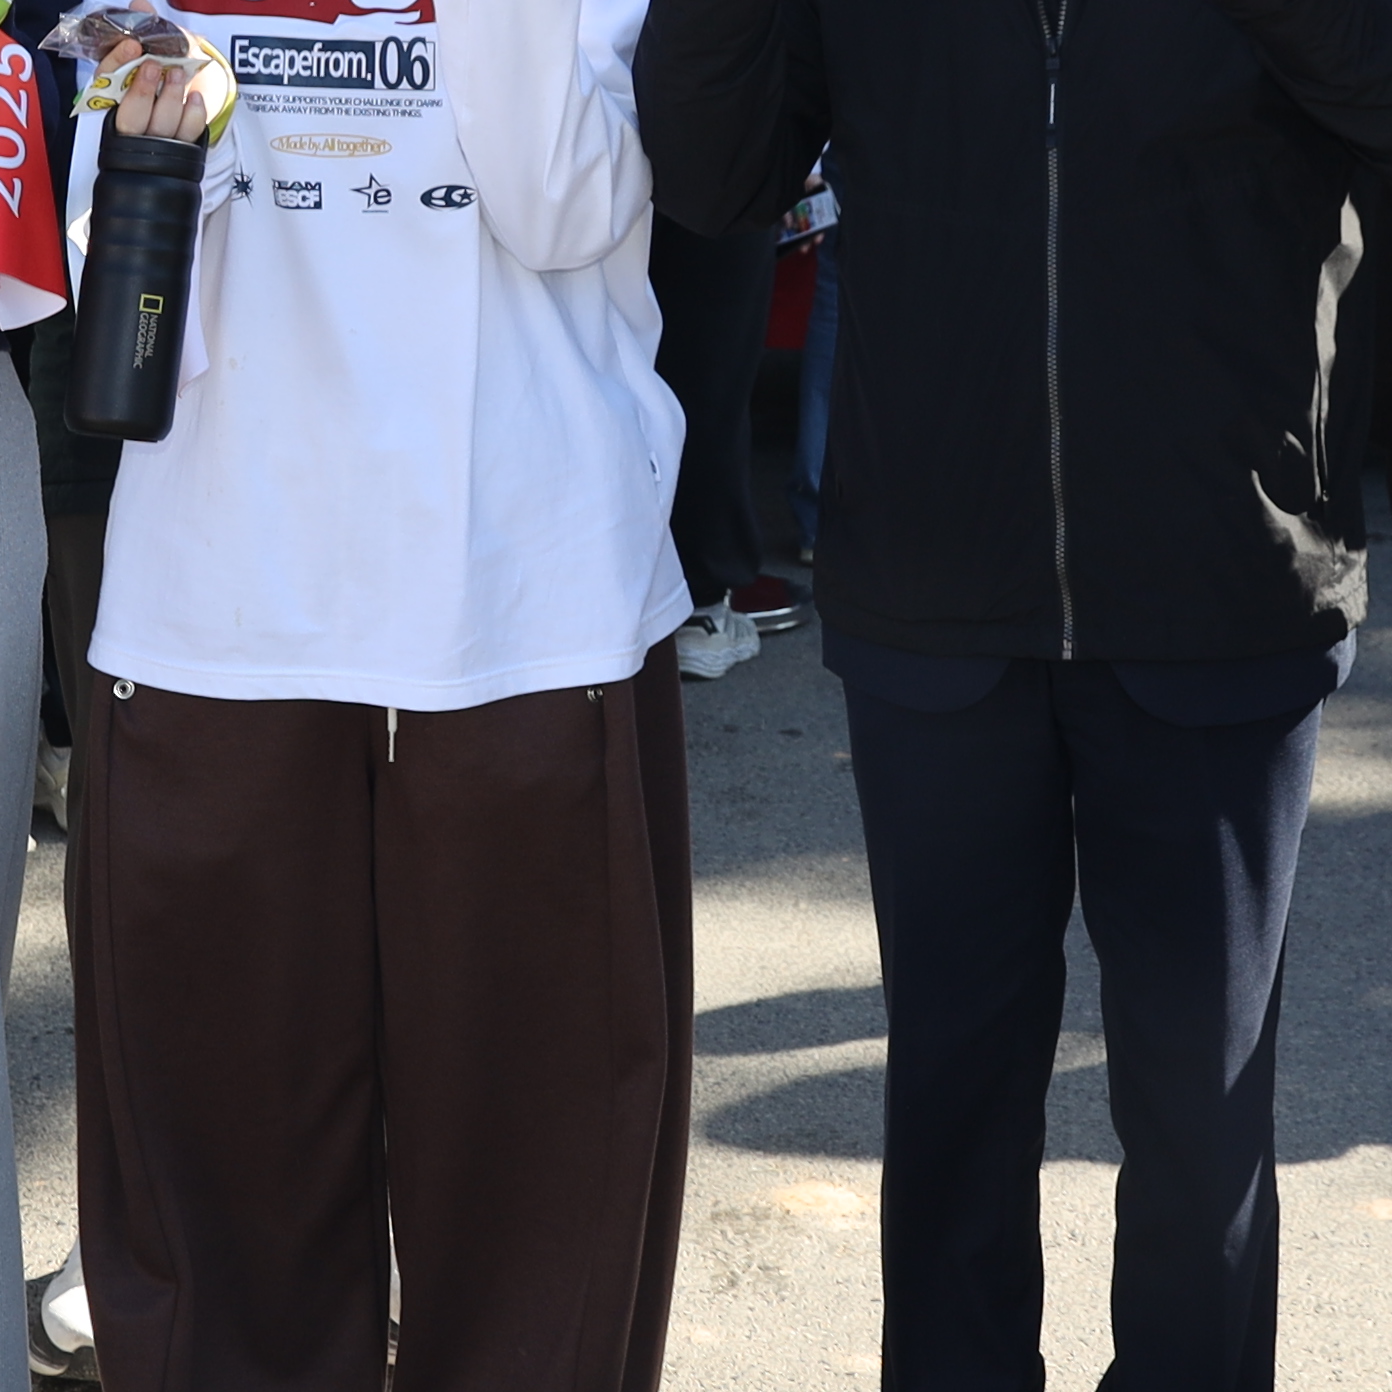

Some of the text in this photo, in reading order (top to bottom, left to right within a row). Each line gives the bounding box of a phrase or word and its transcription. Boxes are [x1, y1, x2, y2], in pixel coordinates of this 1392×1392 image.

[234, 36, 431, 90] Escapefrom. 06
[281, 105, 307, 115] AWAY
[309, 106, 335, 116] FROM
[335, 107, 352, 116] THE
[353, 107, 391, 118] EXISTING
[283, 94, 327, 105] SUPPORTS
[328, 96, 352, 106] YOUR
[353, 97, 403, 107] CHALLENGE
[404, 98, 416, 108] OF
[133, 313, 149, 369] GEOGRAPHIC
[144, 314, 158, 358] NATIONAL
